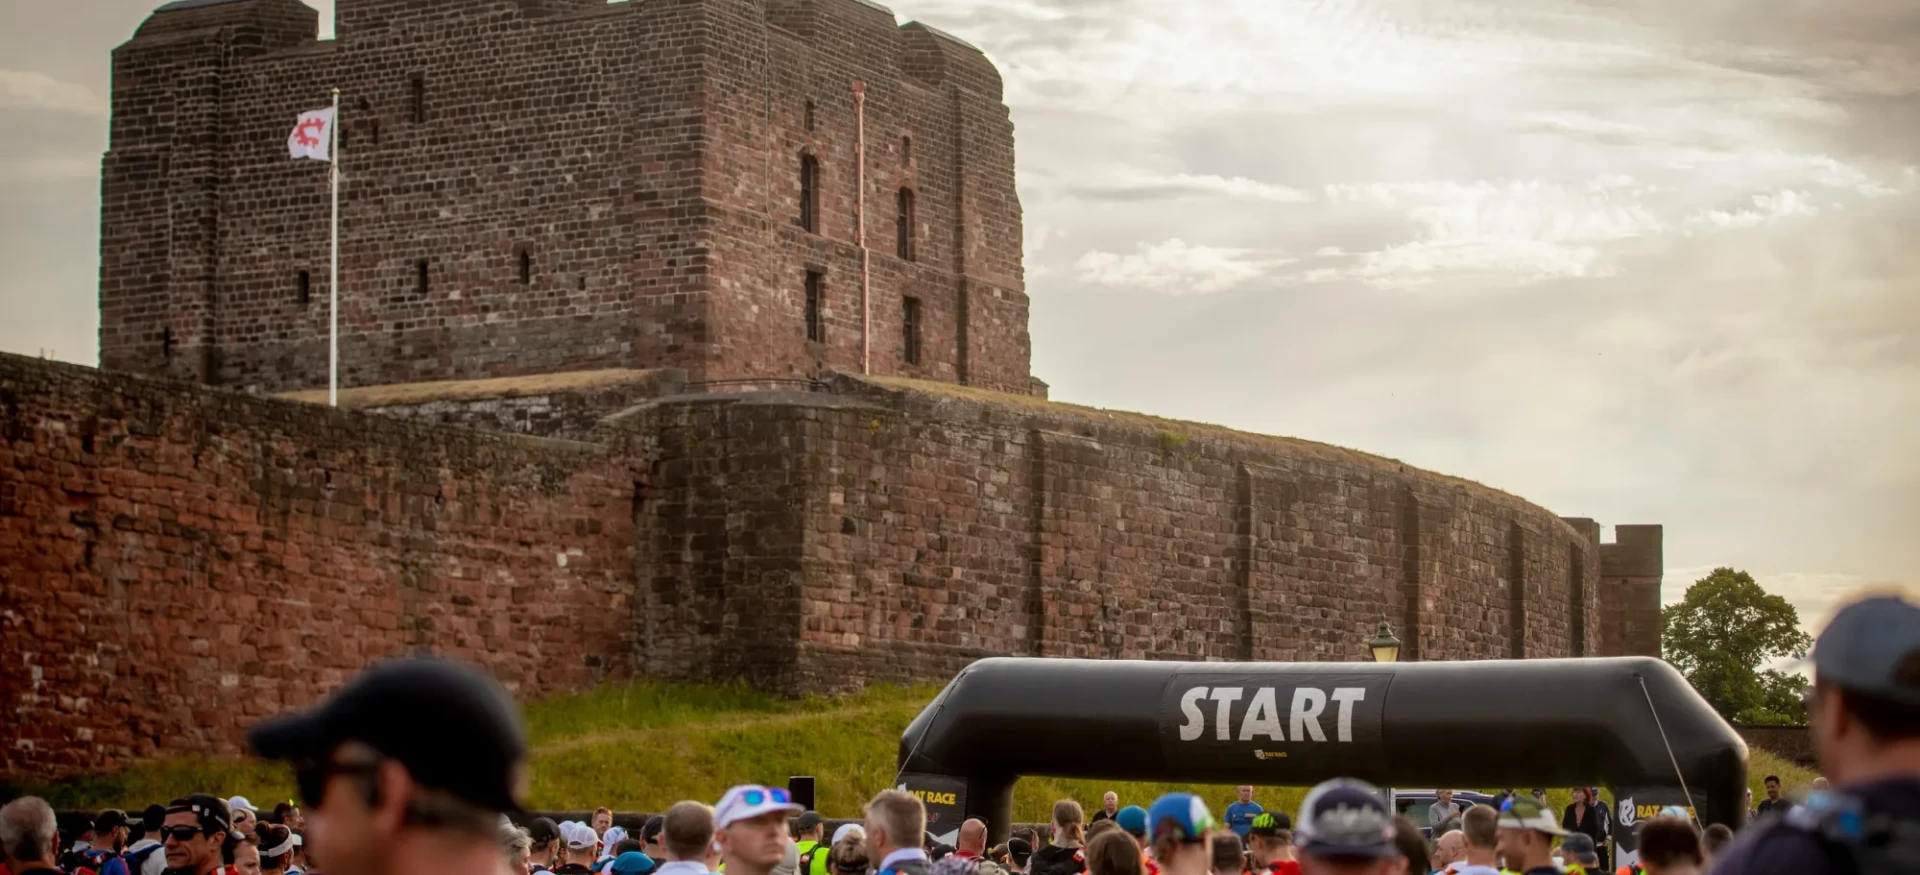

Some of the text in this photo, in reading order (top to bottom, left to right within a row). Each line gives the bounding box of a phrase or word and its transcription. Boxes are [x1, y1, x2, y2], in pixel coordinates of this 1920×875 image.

[1179, 686, 1366, 742] START
[927, 791, 956, 805] RACE
[1637, 804, 1660, 818] RAT
